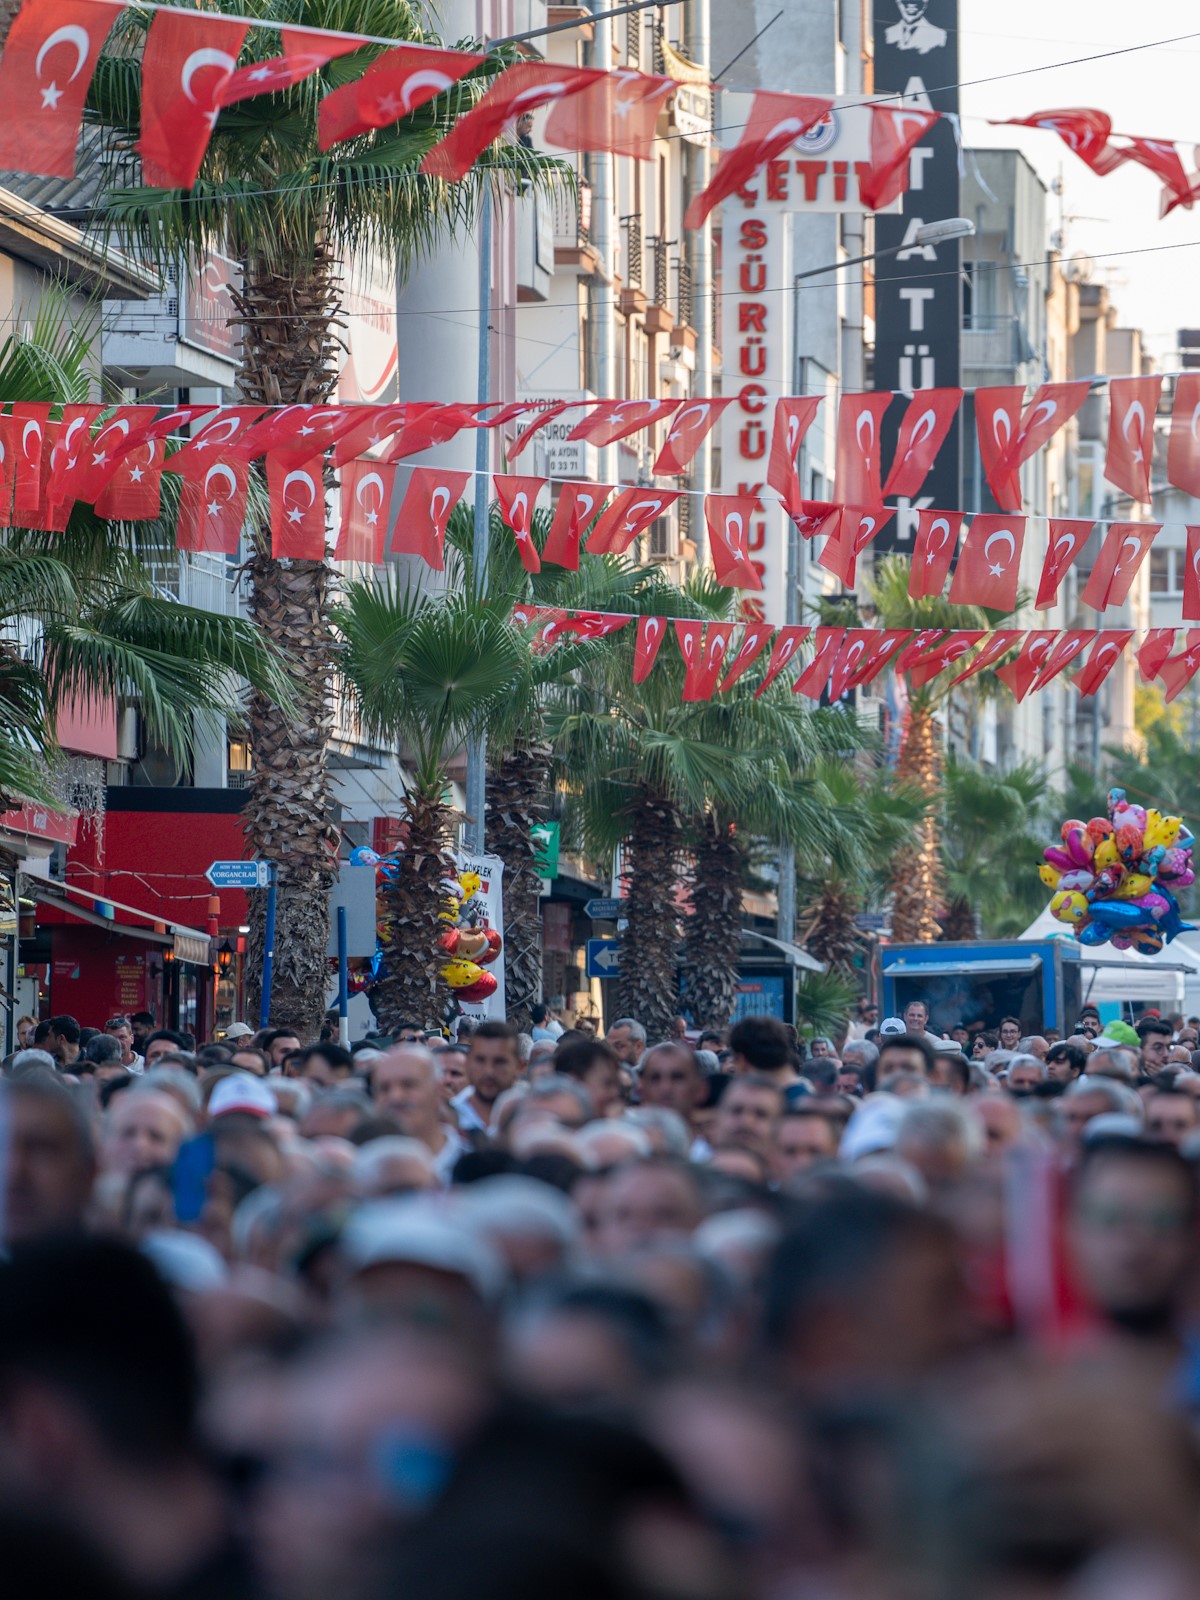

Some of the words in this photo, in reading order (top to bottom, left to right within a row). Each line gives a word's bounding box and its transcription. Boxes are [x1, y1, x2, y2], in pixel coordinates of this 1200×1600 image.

[738, 219, 768, 459] SÜRÜCÜ
[896, 76, 937, 540] ATATÜK
[558, 461, 568, 470] 33
[570, 461, 578, 470] 71
[467, 899, 488, 909] EYAZ
